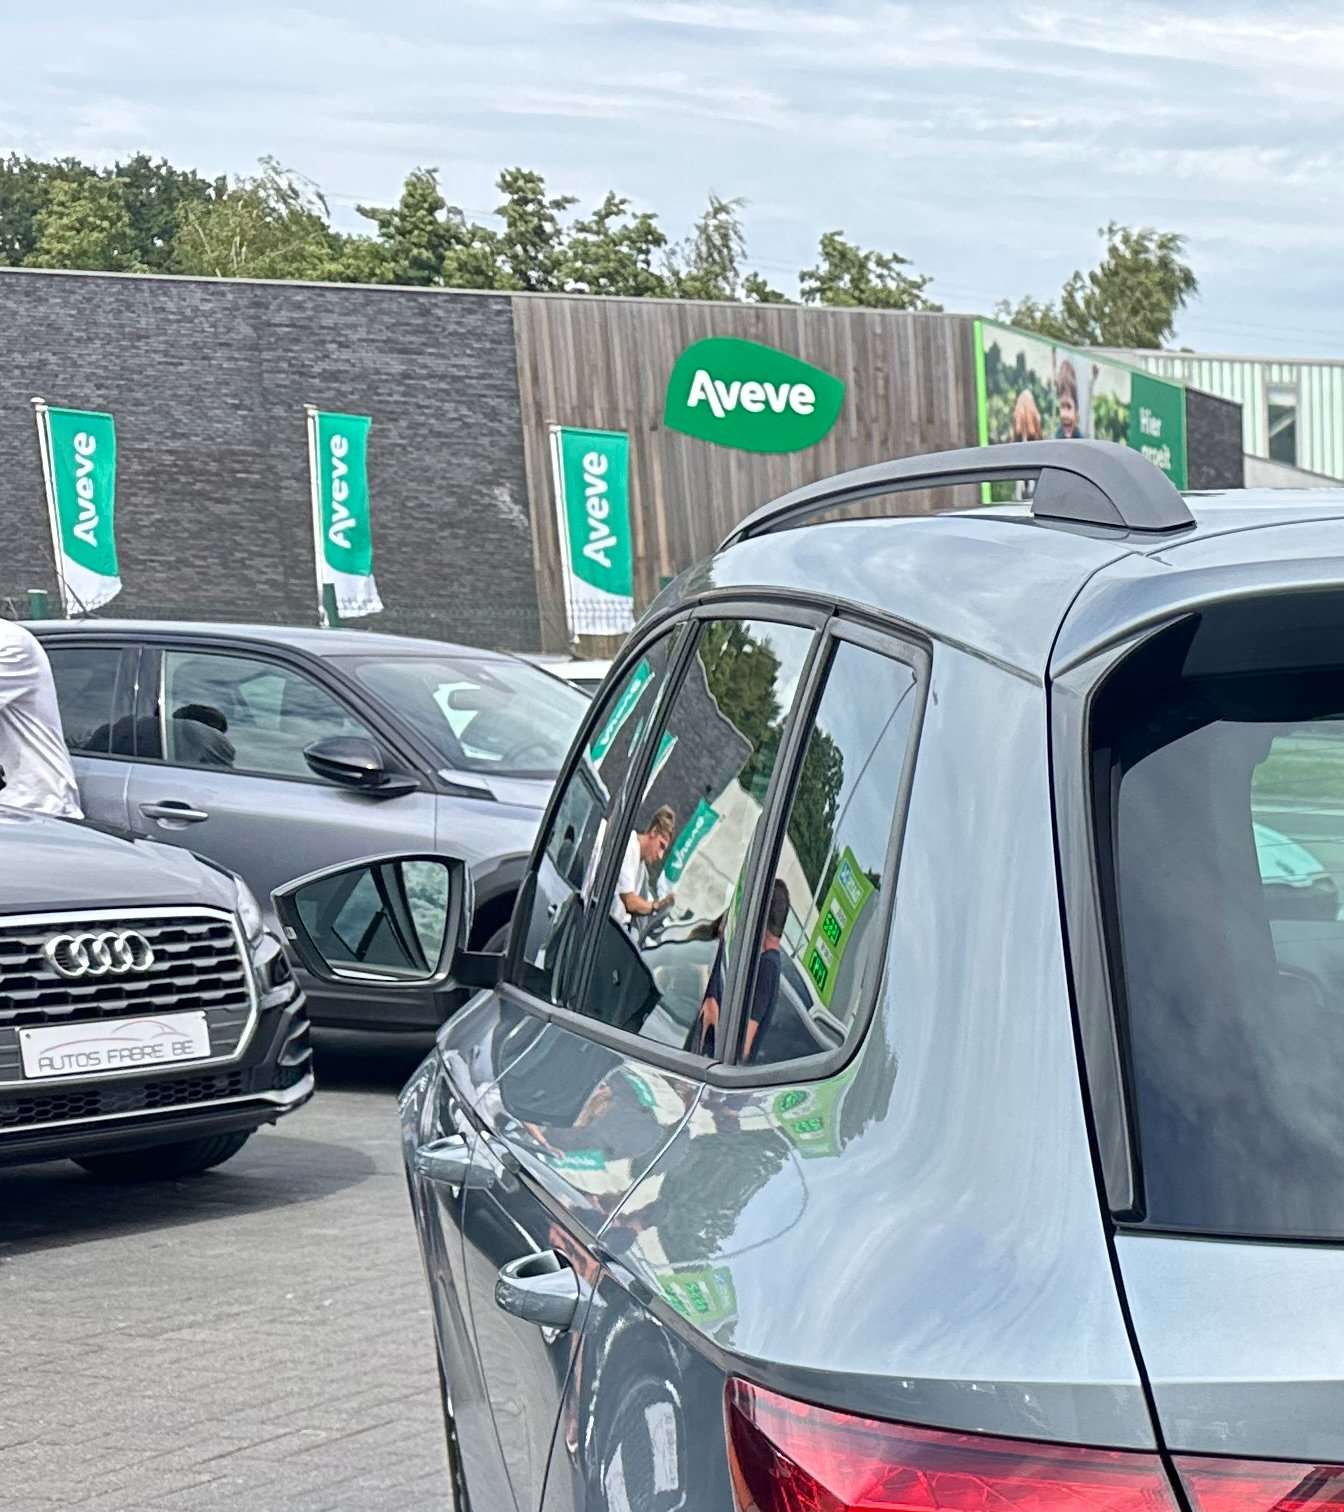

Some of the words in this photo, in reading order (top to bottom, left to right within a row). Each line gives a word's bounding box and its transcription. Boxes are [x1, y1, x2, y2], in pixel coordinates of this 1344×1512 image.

[688, 368, 816, 417] Aveve
[74, 432, 97, 546] Aveve
[329, 434, 352, 548] Aveve
[583, 451, 612, 567] Aveve
[38, 1052, 101, 1072] AUTOS
[107, 1044, 164, 1064] FABRE
[171, 1039, 195, 1056] BE
